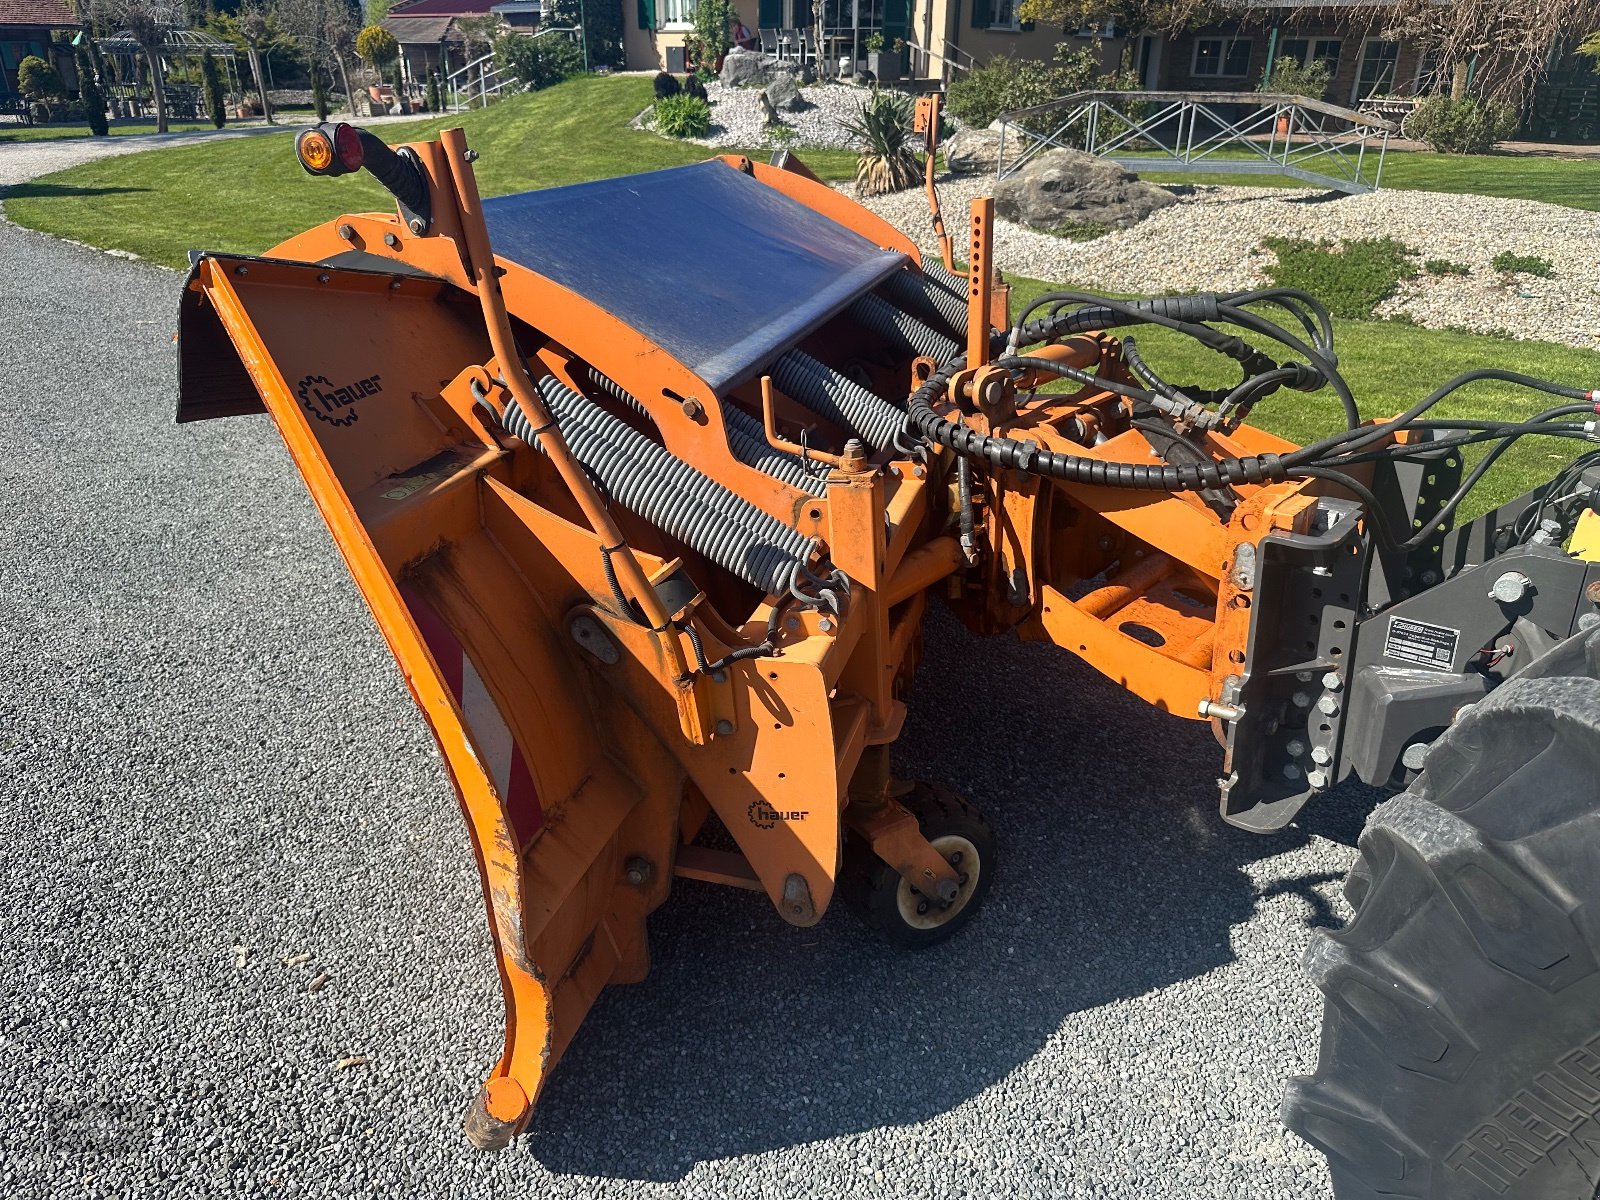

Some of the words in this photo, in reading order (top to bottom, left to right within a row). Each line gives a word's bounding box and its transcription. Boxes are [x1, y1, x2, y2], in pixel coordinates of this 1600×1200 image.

[313, 374, 383, 412] hauer
[758, 806, 809, 820] hauer
[1442, 1033, 1600, 1196] TRELLE
